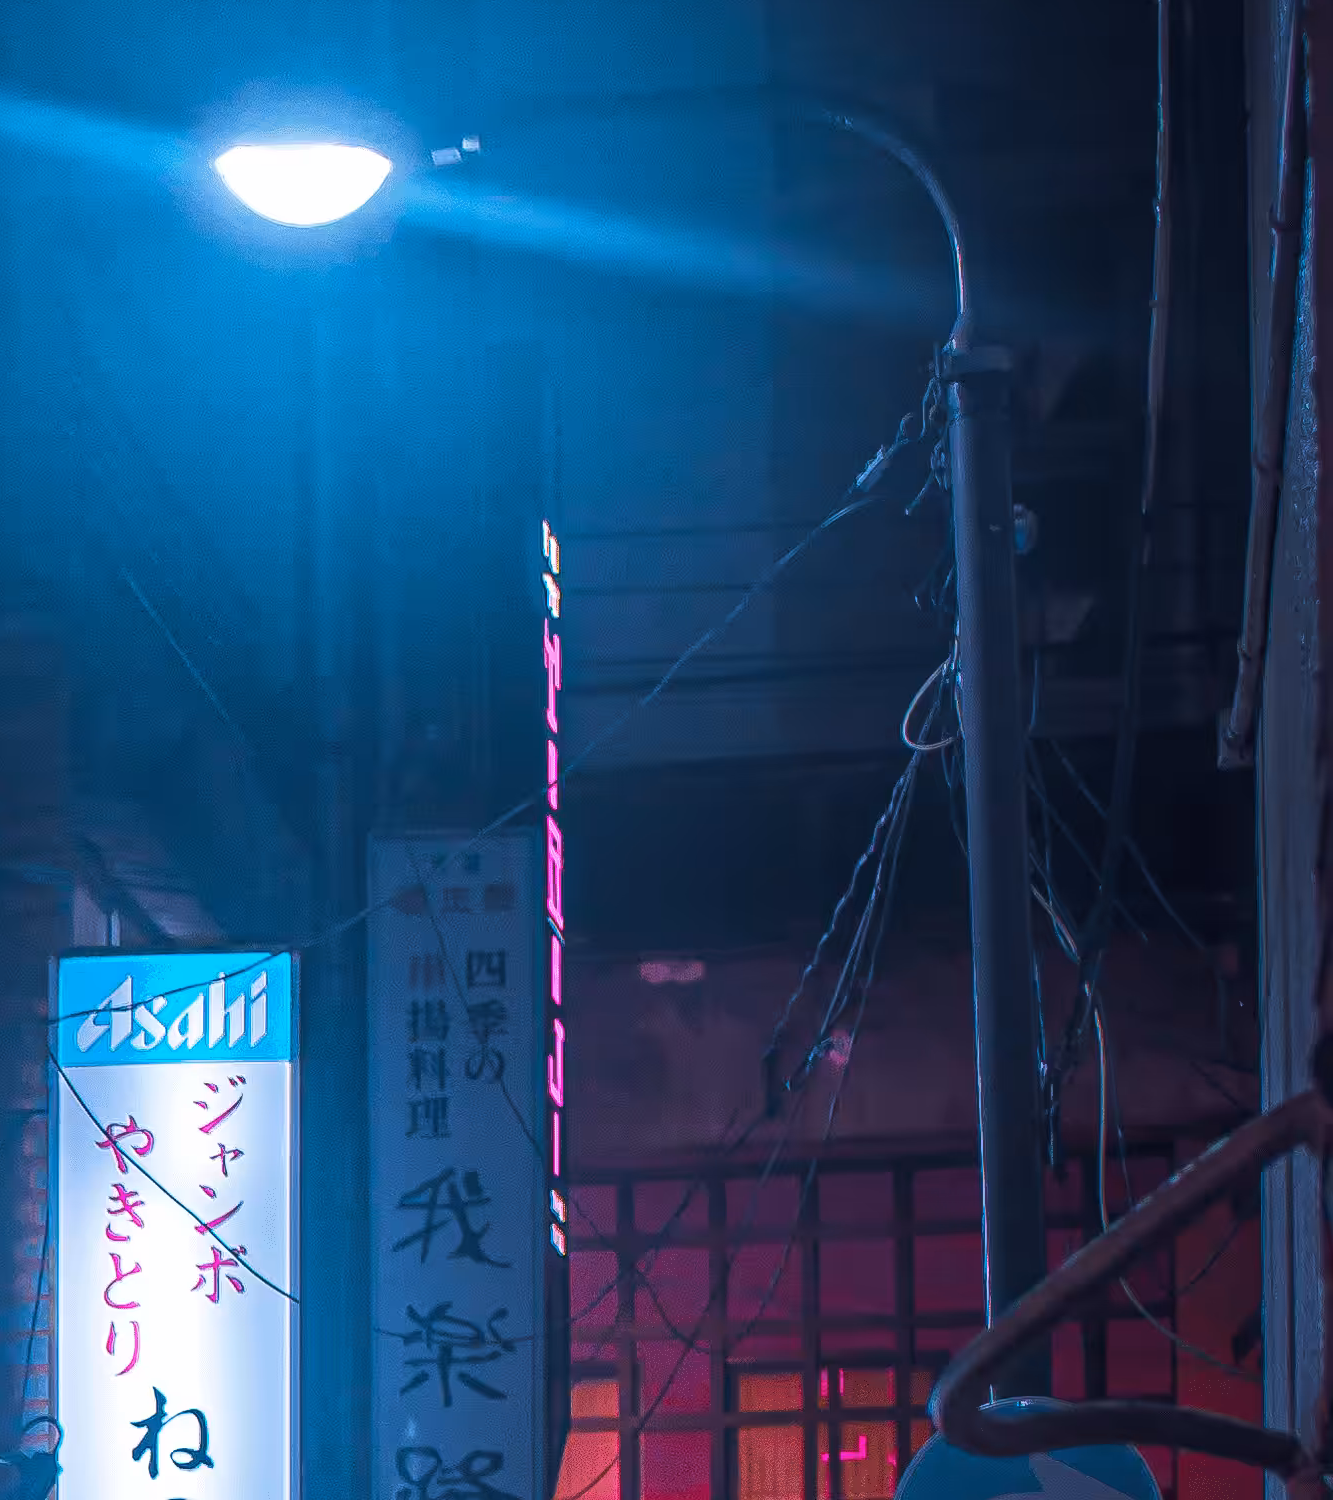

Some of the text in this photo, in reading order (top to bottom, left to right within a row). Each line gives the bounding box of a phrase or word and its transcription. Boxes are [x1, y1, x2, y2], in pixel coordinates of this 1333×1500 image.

[76, 970, 268, 1053] Asahi
[465, 949, 508, 1083] 四季の
[95, 1114, 155, 1377] やきとり
[190, 1074, 247, 1304] ジャンボ
